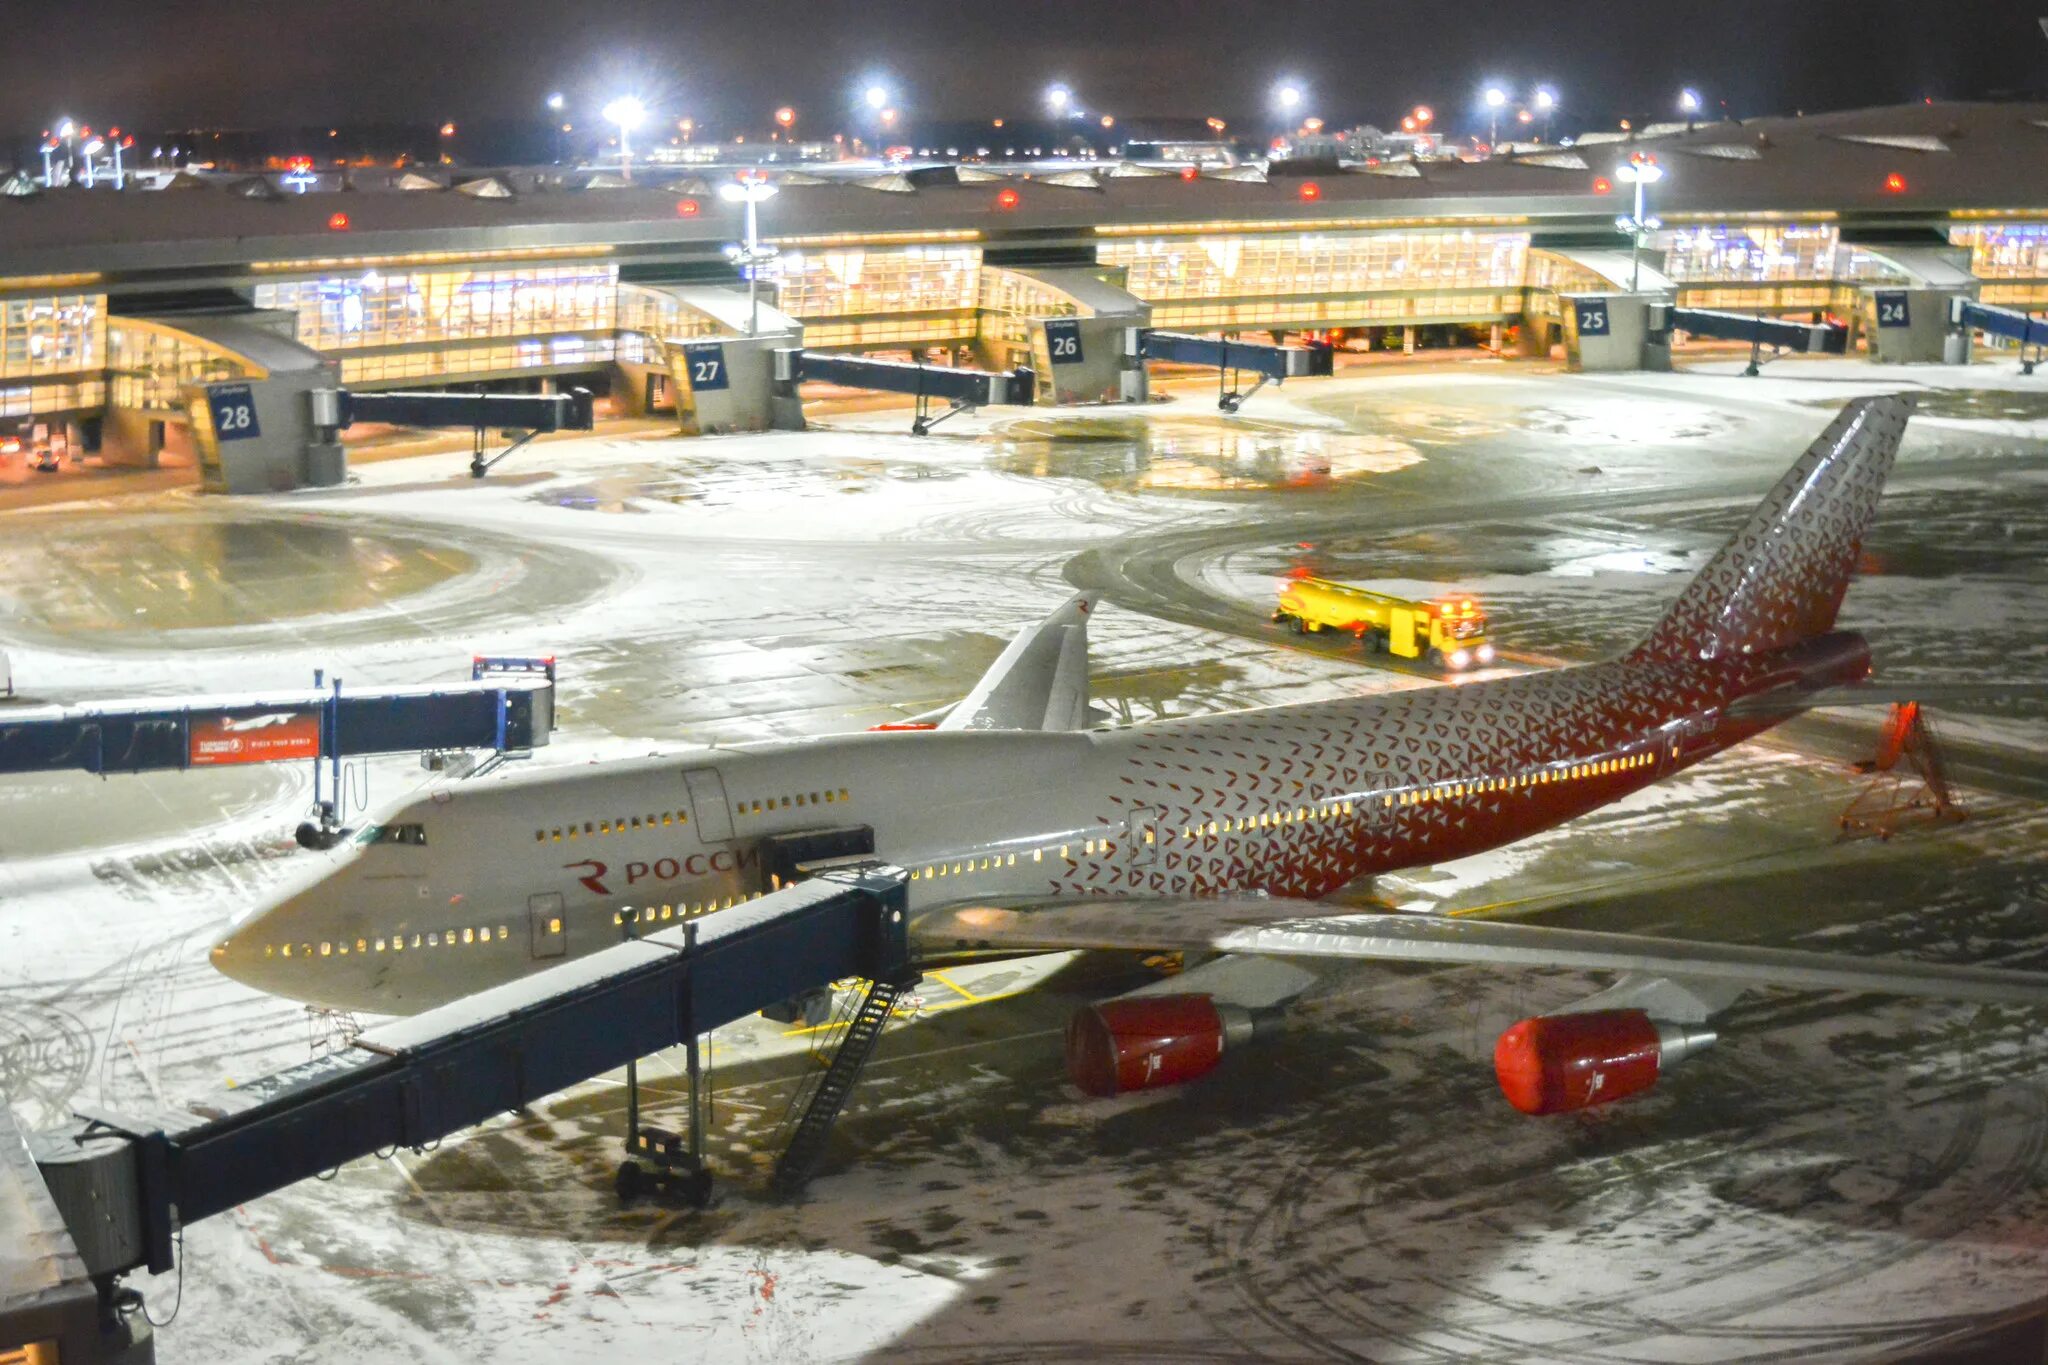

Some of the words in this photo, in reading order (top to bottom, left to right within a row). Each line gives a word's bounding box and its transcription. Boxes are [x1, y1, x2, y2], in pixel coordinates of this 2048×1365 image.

[1582, 311, 1604, 329] 25
[1881, 303, 1904, 321] 24
[1053, 337, 1077, 356] 26
[694, 361, 719, 382] 27
[220, 405, 250, 430] 28
